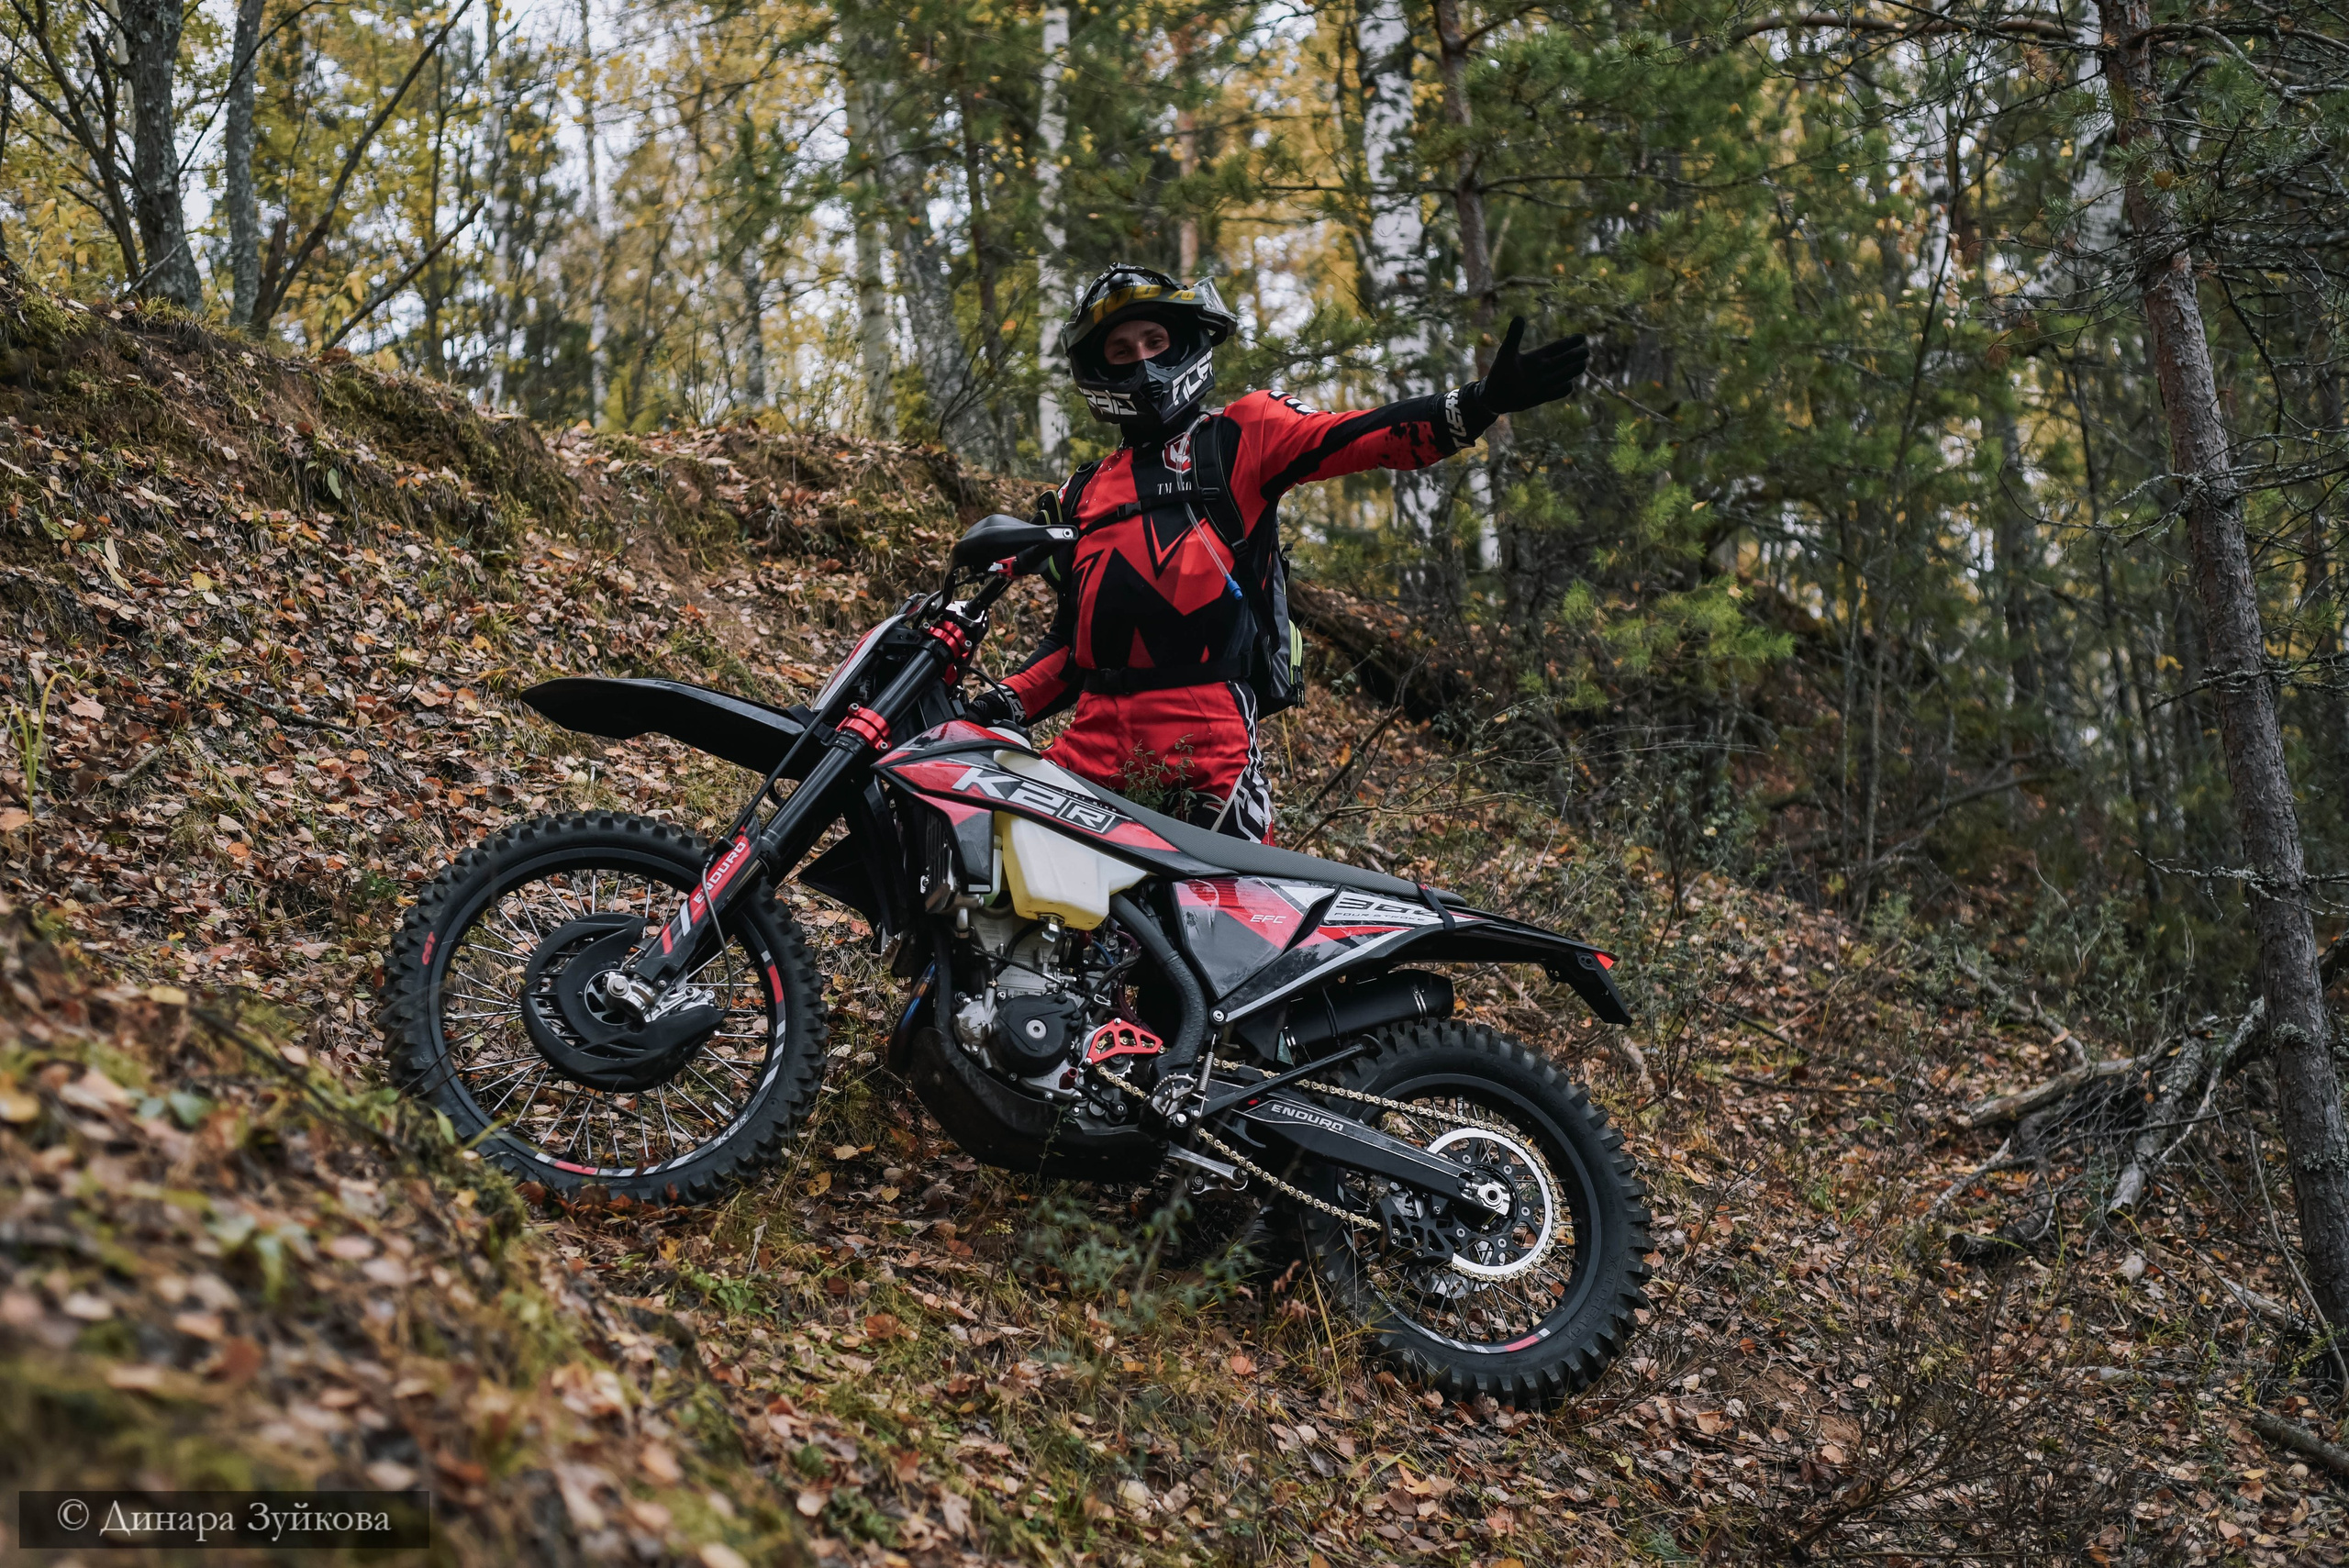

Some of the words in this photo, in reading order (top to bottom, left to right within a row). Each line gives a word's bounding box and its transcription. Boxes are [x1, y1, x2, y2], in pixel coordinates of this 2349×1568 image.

[952, 767, 1113, 832] K2R
[693, 841, 747, 905] ENDURO
[1250, 914, 1287, 924] EFC
[1271, 1104, 1344, 1131] ENDURO
